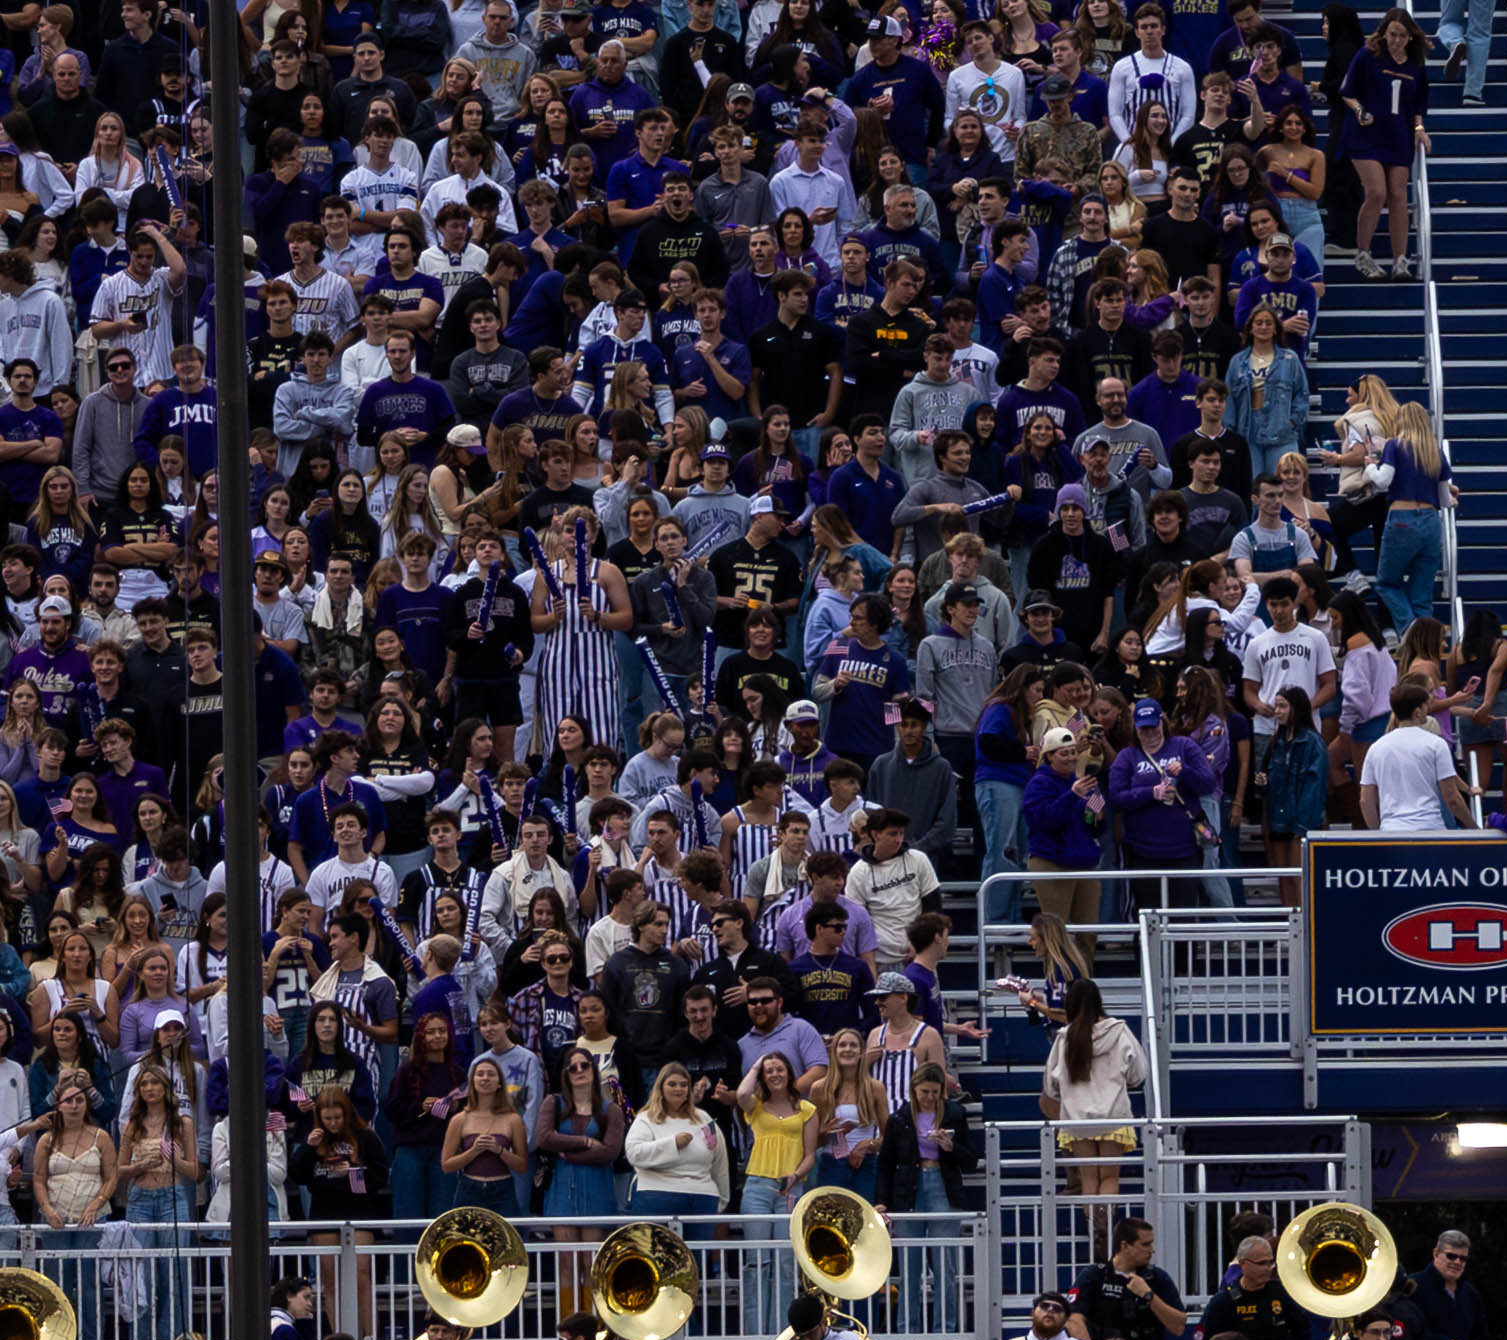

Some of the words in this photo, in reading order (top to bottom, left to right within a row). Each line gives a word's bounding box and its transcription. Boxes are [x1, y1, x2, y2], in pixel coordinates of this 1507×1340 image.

[1392, 80, 1401, 114] 1
[659, 237, 702, 251] JMU
[169, 404, 217, 427] JMU
[734, 573, 774, 603] 25
[1261, 644, 1310, 661] MADISON
[24, 666, 73, 692] Dukes
[840, 659, 888, 687] DUKES
[1325, 868, 1469, 889] HOLTZMAN
[1337, 986, 1475, 1006] HOLTZMAN
[1102, 1284, 1122, 1293] POLICE
[1237, 1305, 1257, 1314] POLICE
